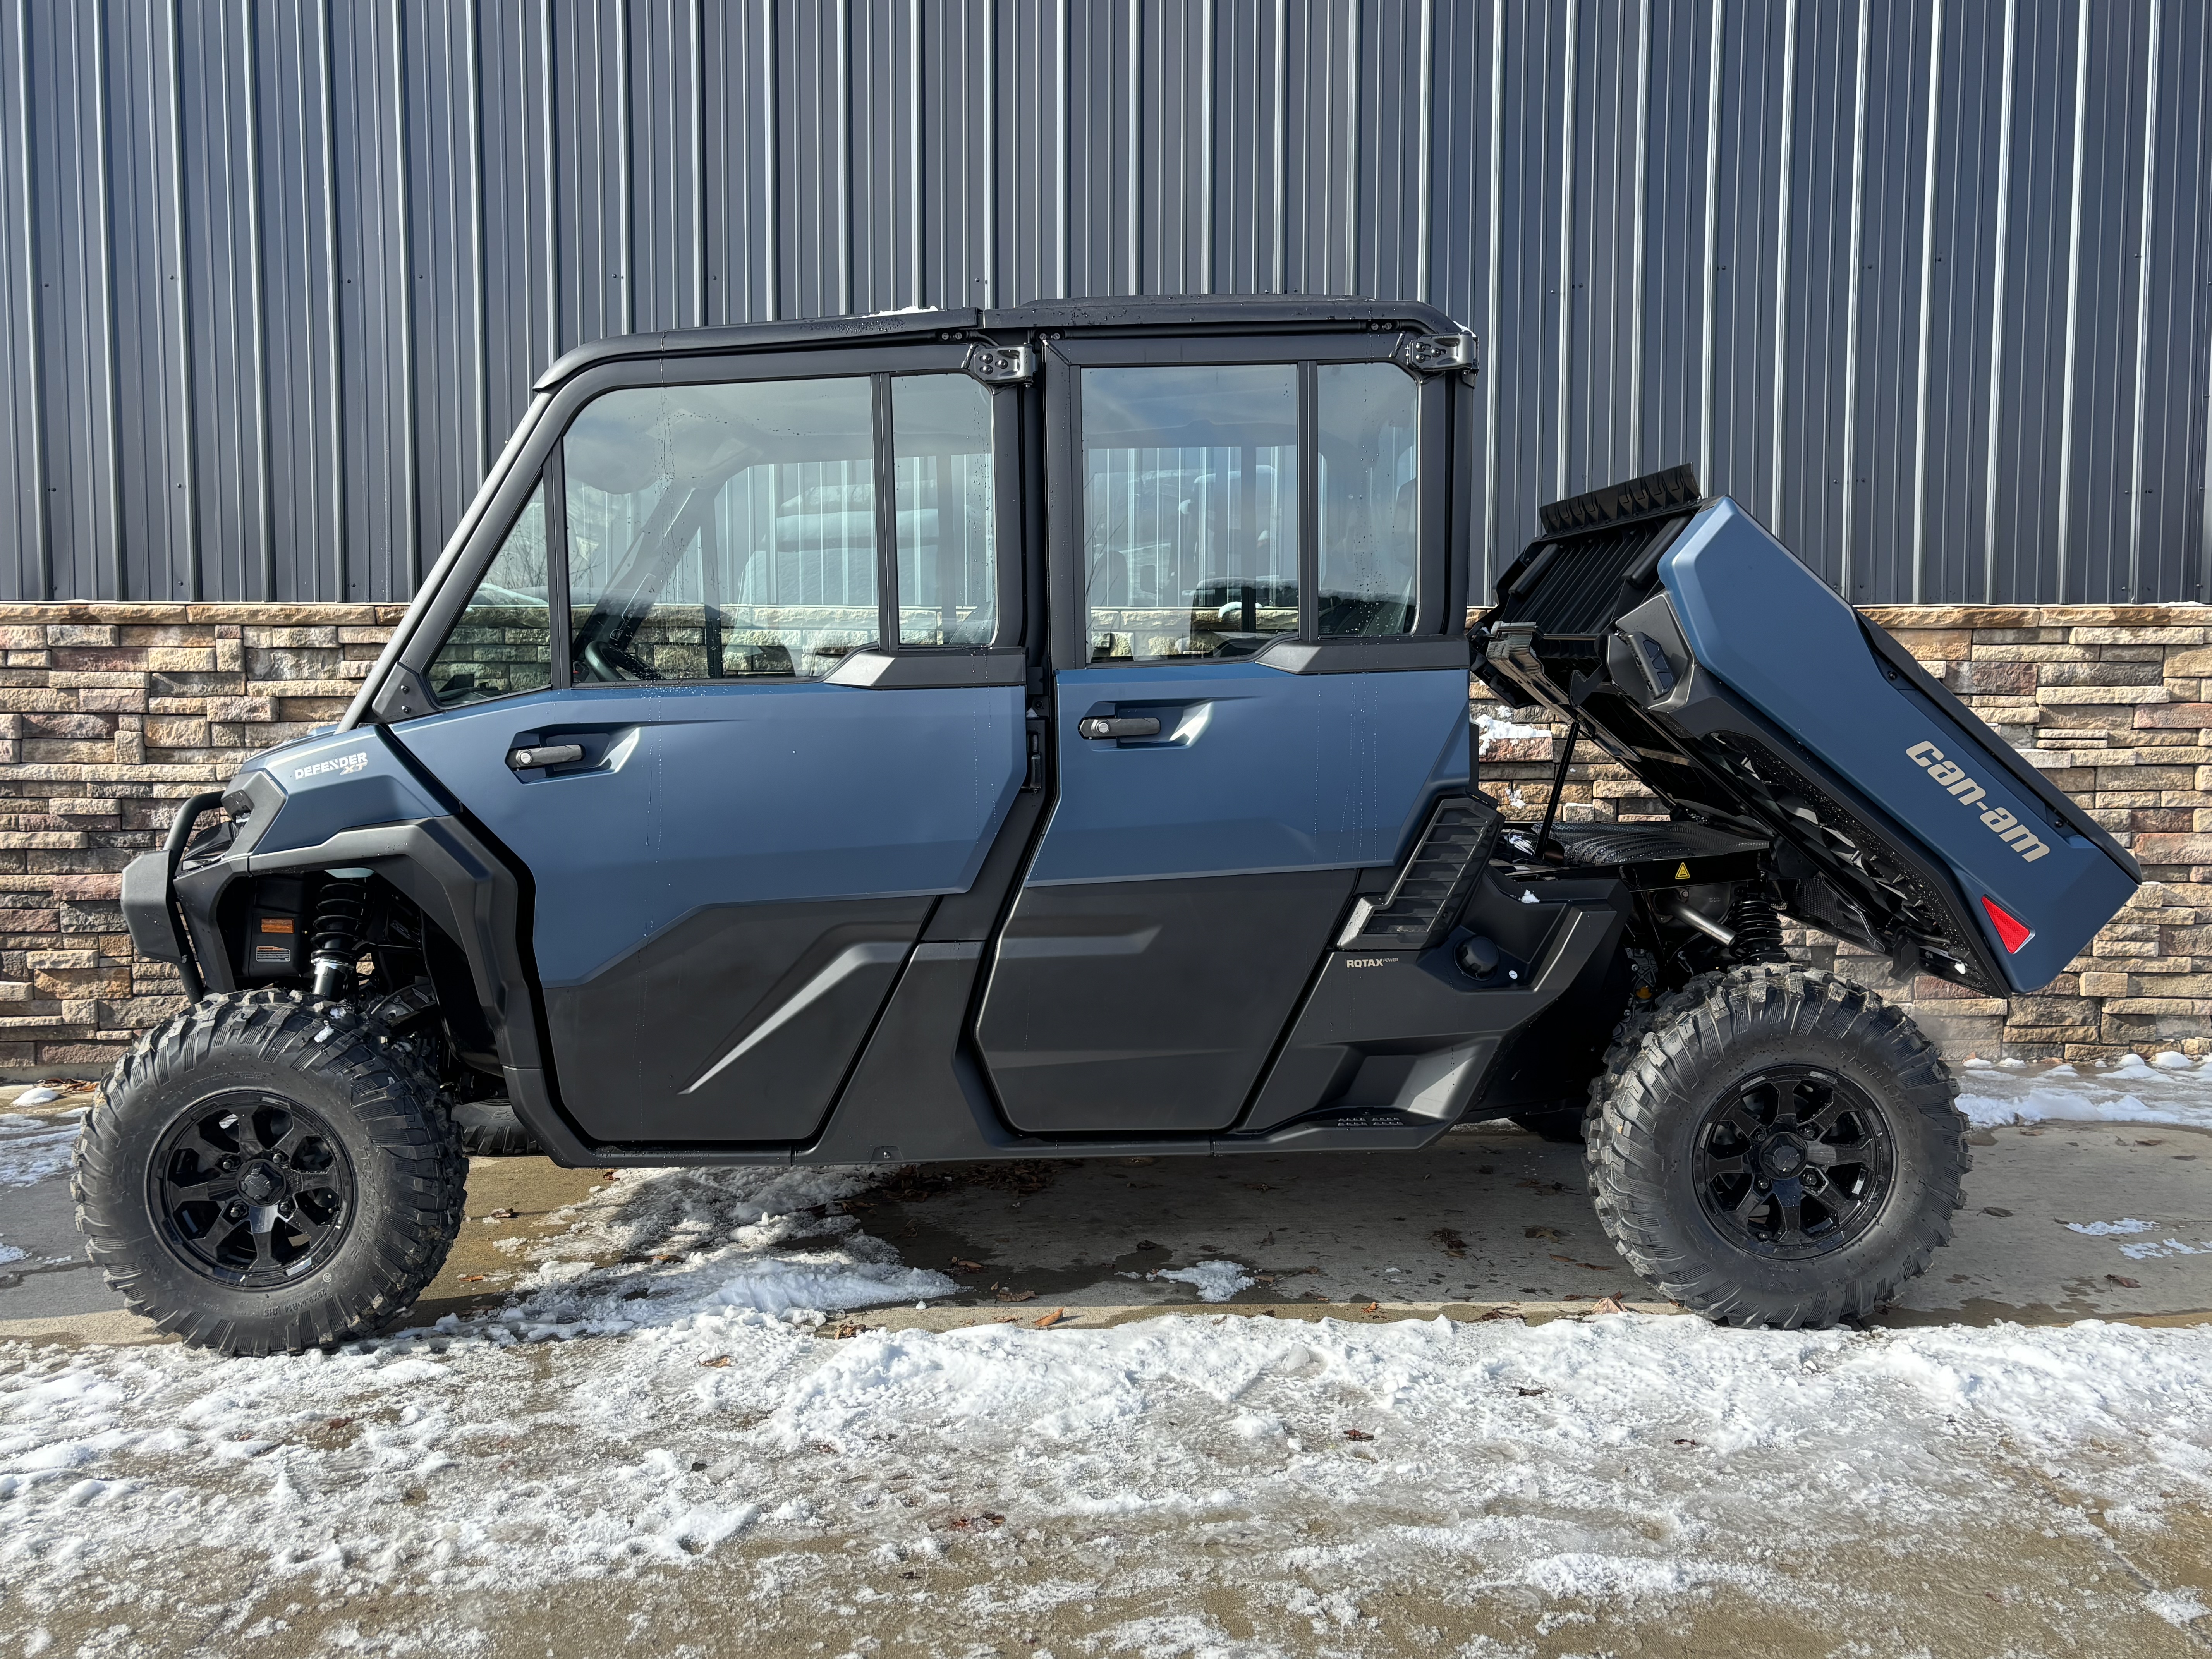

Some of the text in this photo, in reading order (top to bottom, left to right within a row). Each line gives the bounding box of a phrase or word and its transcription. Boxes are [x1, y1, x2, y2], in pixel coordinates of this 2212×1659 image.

[295, 752, 367, 780] DEFENDER
[340, 762, 367, 775] XT
[1346, 958, 1384, 968] ROTAX
